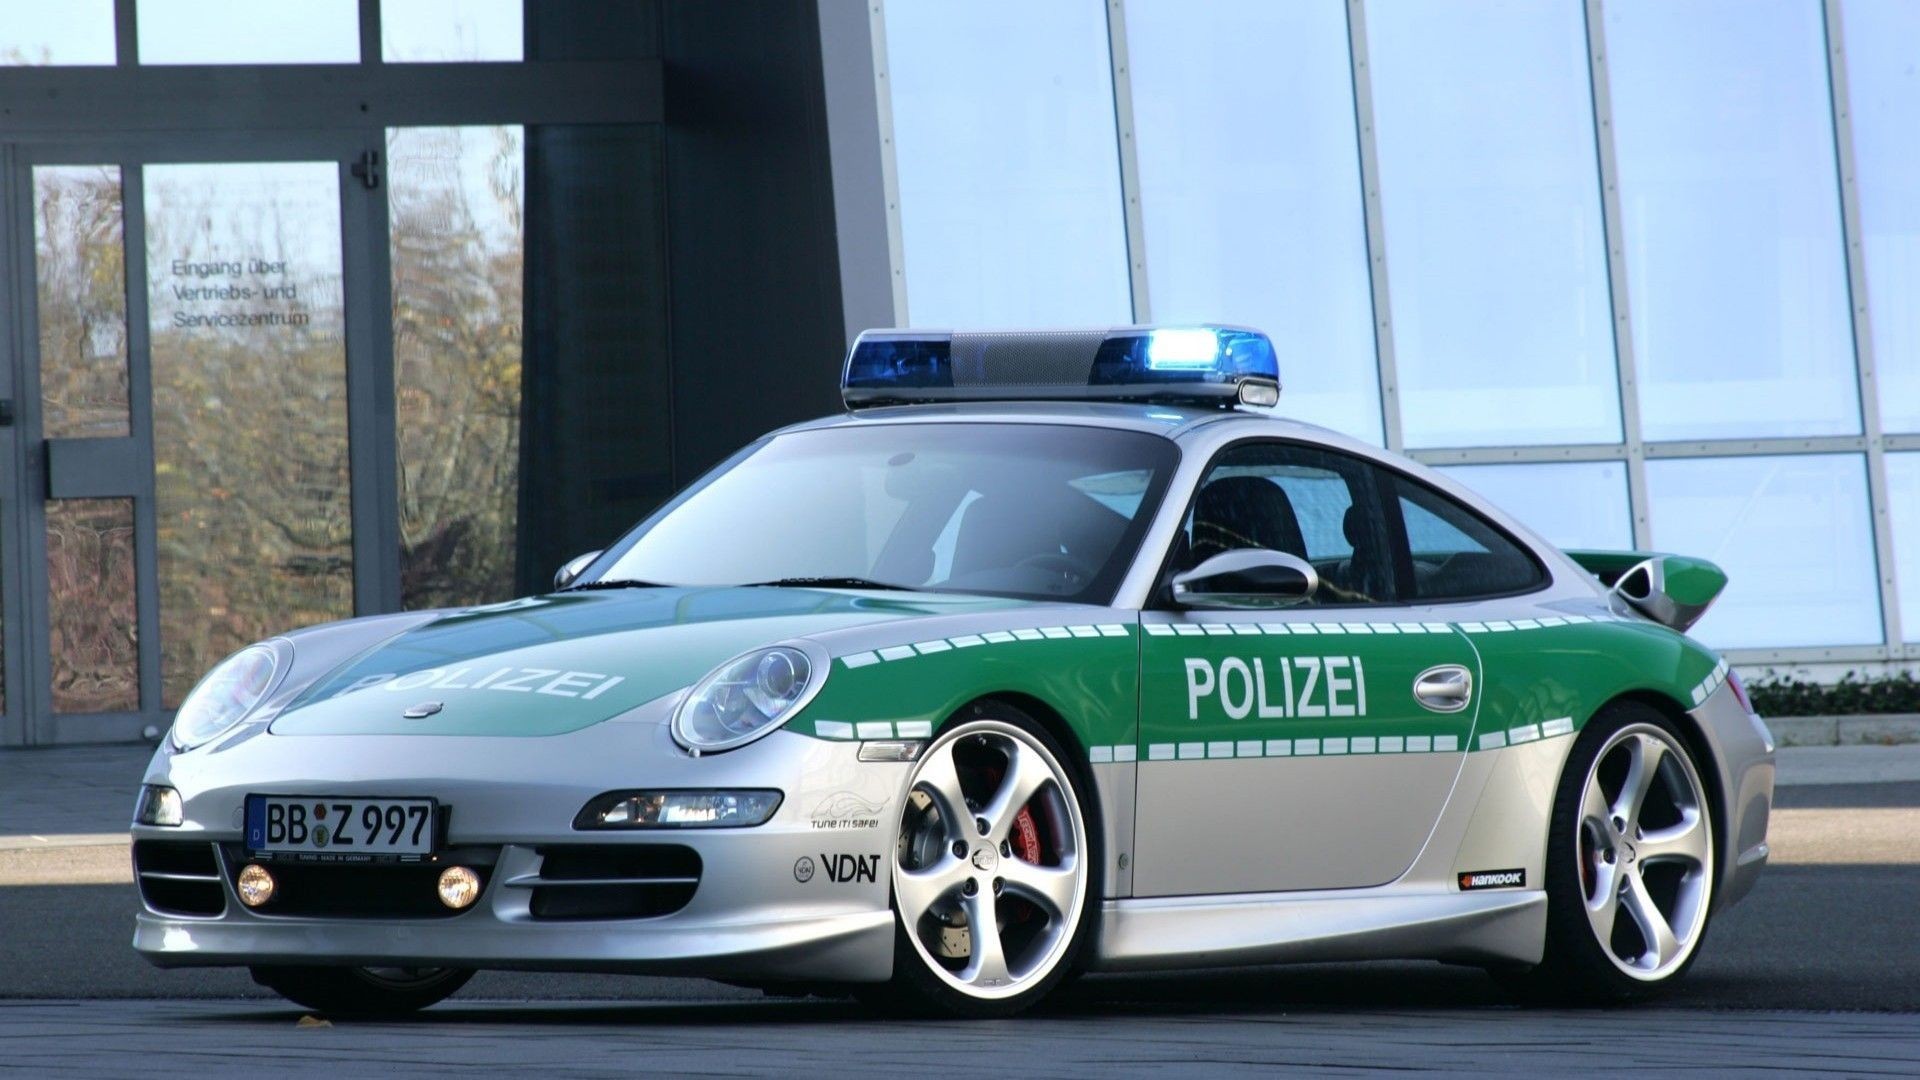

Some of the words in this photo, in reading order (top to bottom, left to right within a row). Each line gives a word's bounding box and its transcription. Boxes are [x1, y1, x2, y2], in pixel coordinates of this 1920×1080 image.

[172, 259, 242, 278] Eingang
[248, 258, 287, 274] über
[173, 284, 258, 300] Vertriebs-
[263, 284, 297, 299] und
[173, 310, 309, 327] Servicezentrum
[332, 667, 625, 700] POLIZEI
[1184, 655, 1367, 720] POLIZEI
[253, 830, 260, 841] D
[267, 804, 308, 844] BB
[332, 804, 354, 845] Z
[362, 805, 429, 846] 997
[820, 853, 881, 883] VDAT
